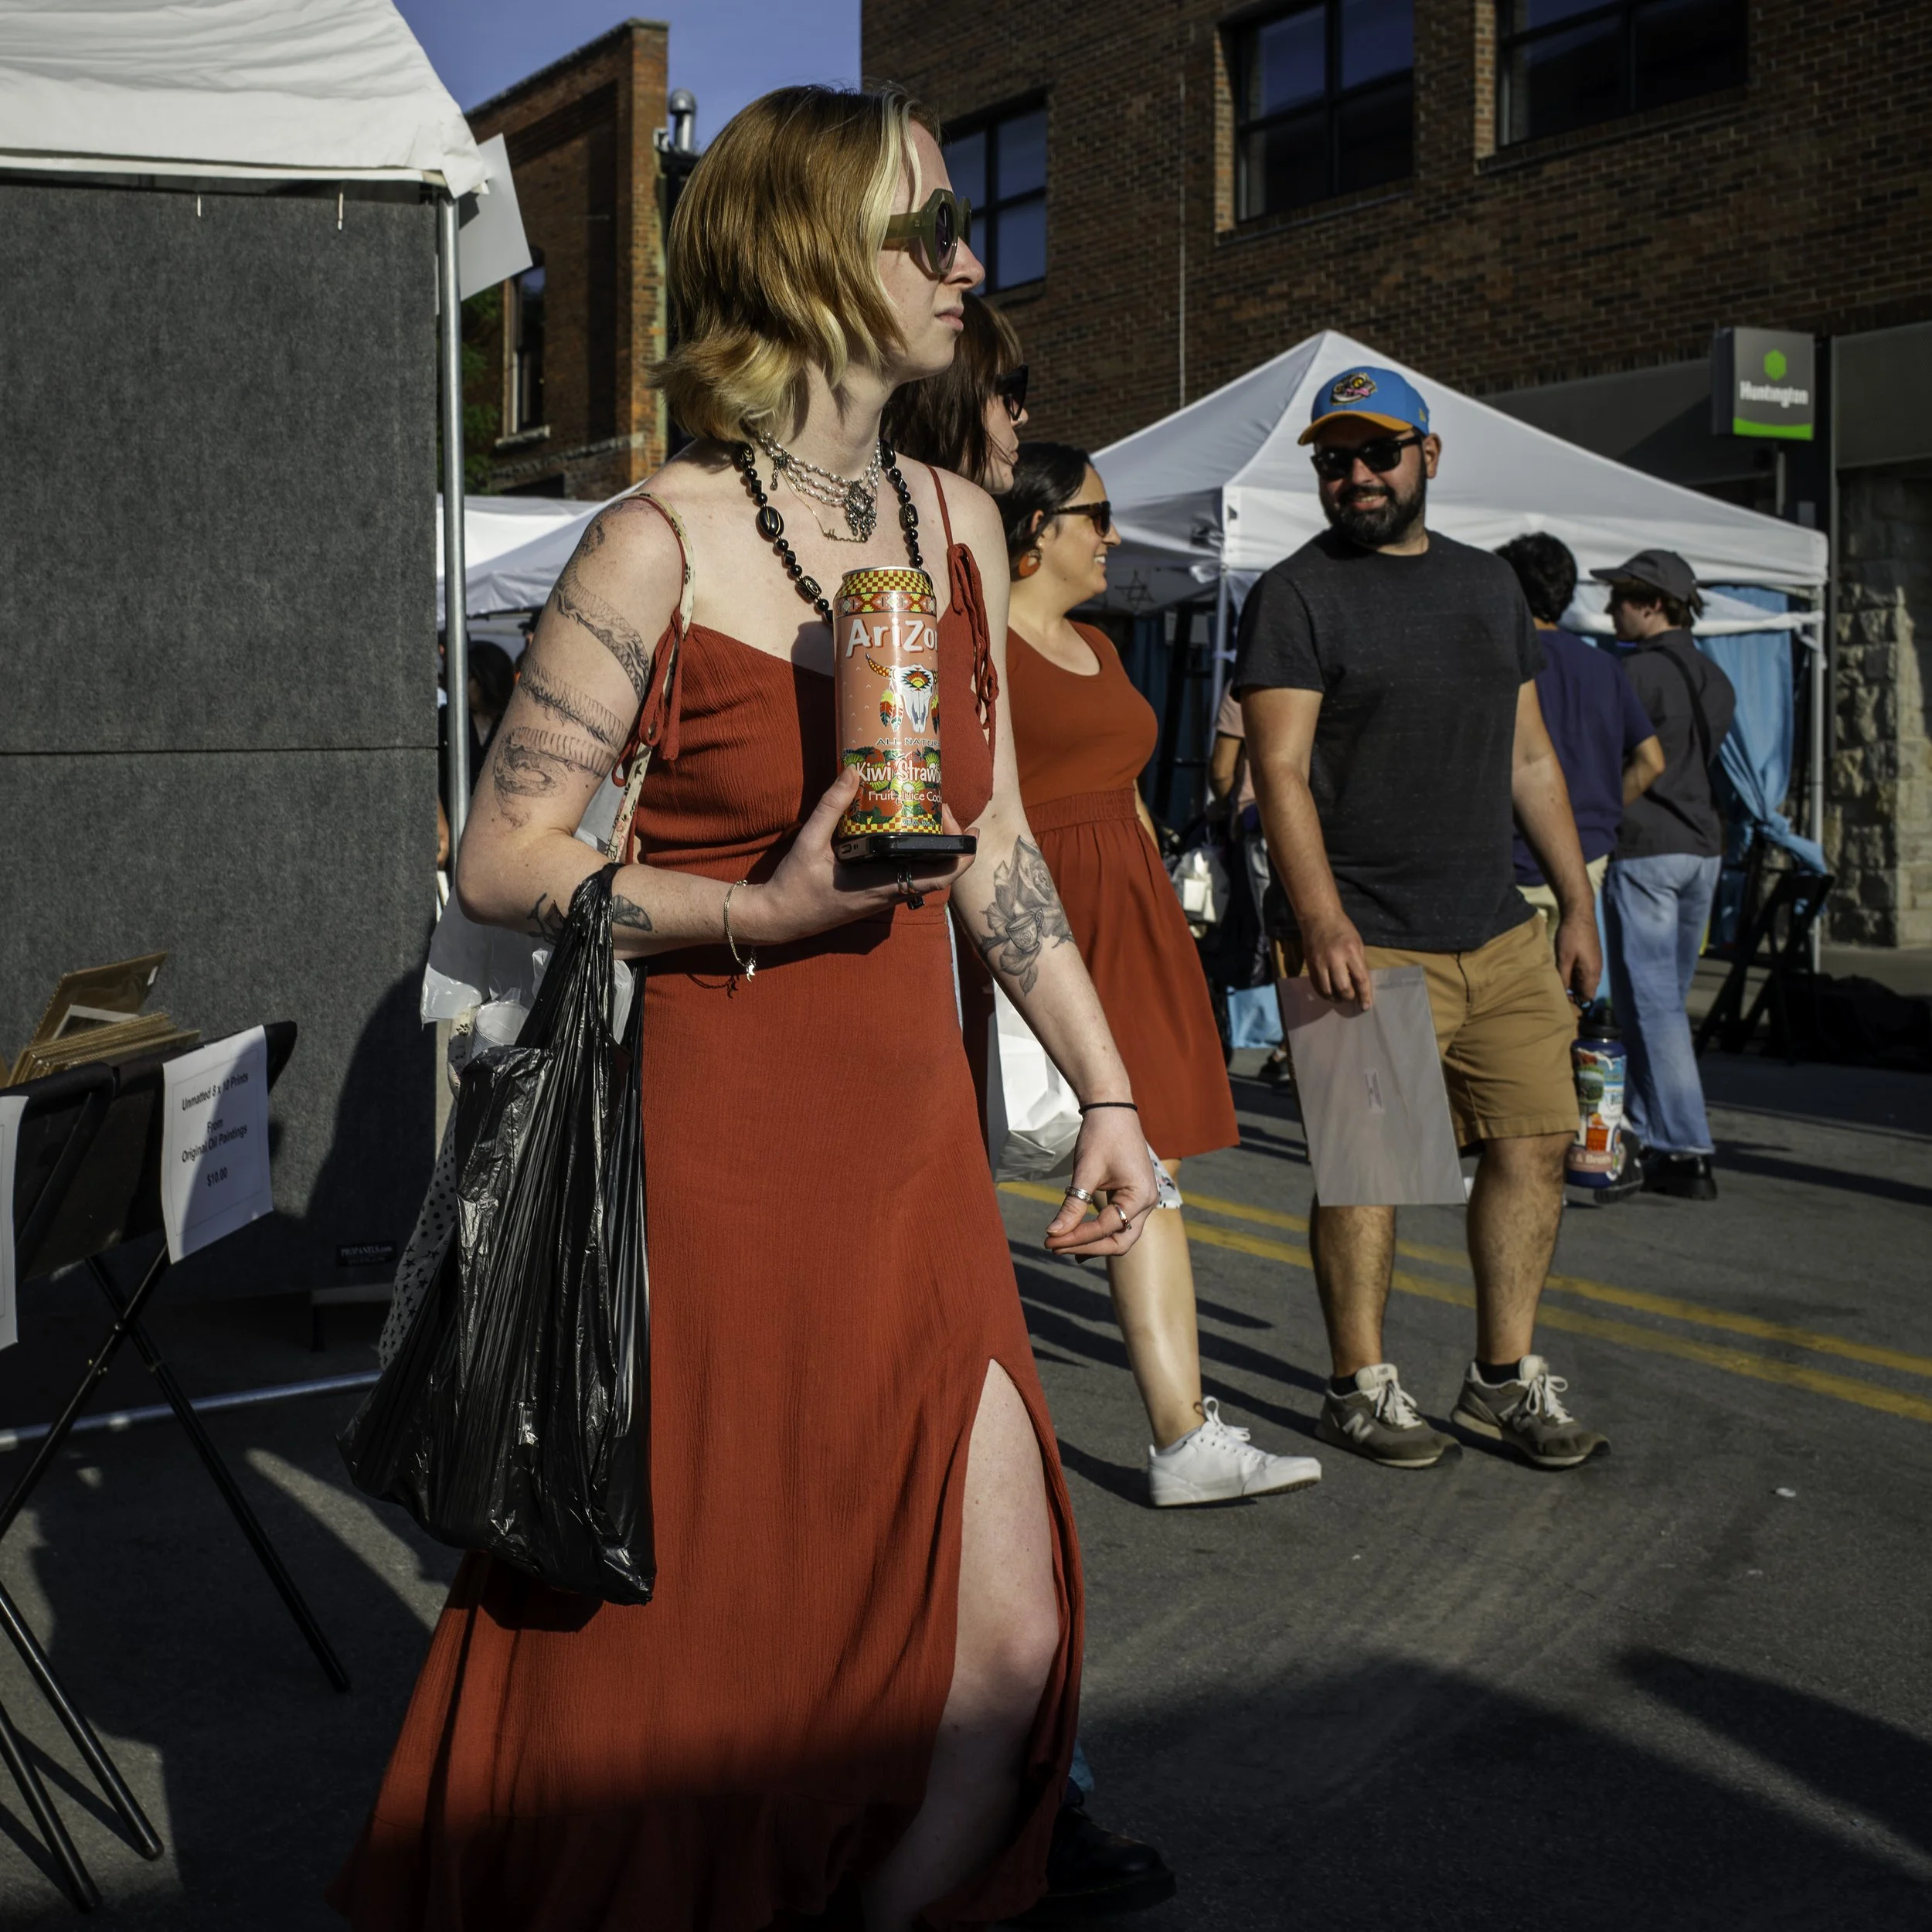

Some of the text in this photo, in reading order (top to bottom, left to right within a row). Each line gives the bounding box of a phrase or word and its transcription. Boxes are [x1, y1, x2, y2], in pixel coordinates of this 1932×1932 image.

[1740, 379, 1808, 408] Huntington
[876, 737, 901, 746] ALL
[856, 761, 892, 782] Kiwi
[869, 790, 896, 801] Fruit
[898, 790, 925, 801] Juice
[182, 1086, 211, 1111] Unmatted
[217, 1085, 221, 1094] x
[230, 1073, 249, 1088] Prints
[207, 1119, 223, 1134] From
[182, 1124, 247, 1162] Original Oil Paintings
[207, 1166, 228, 1187] $10.00
